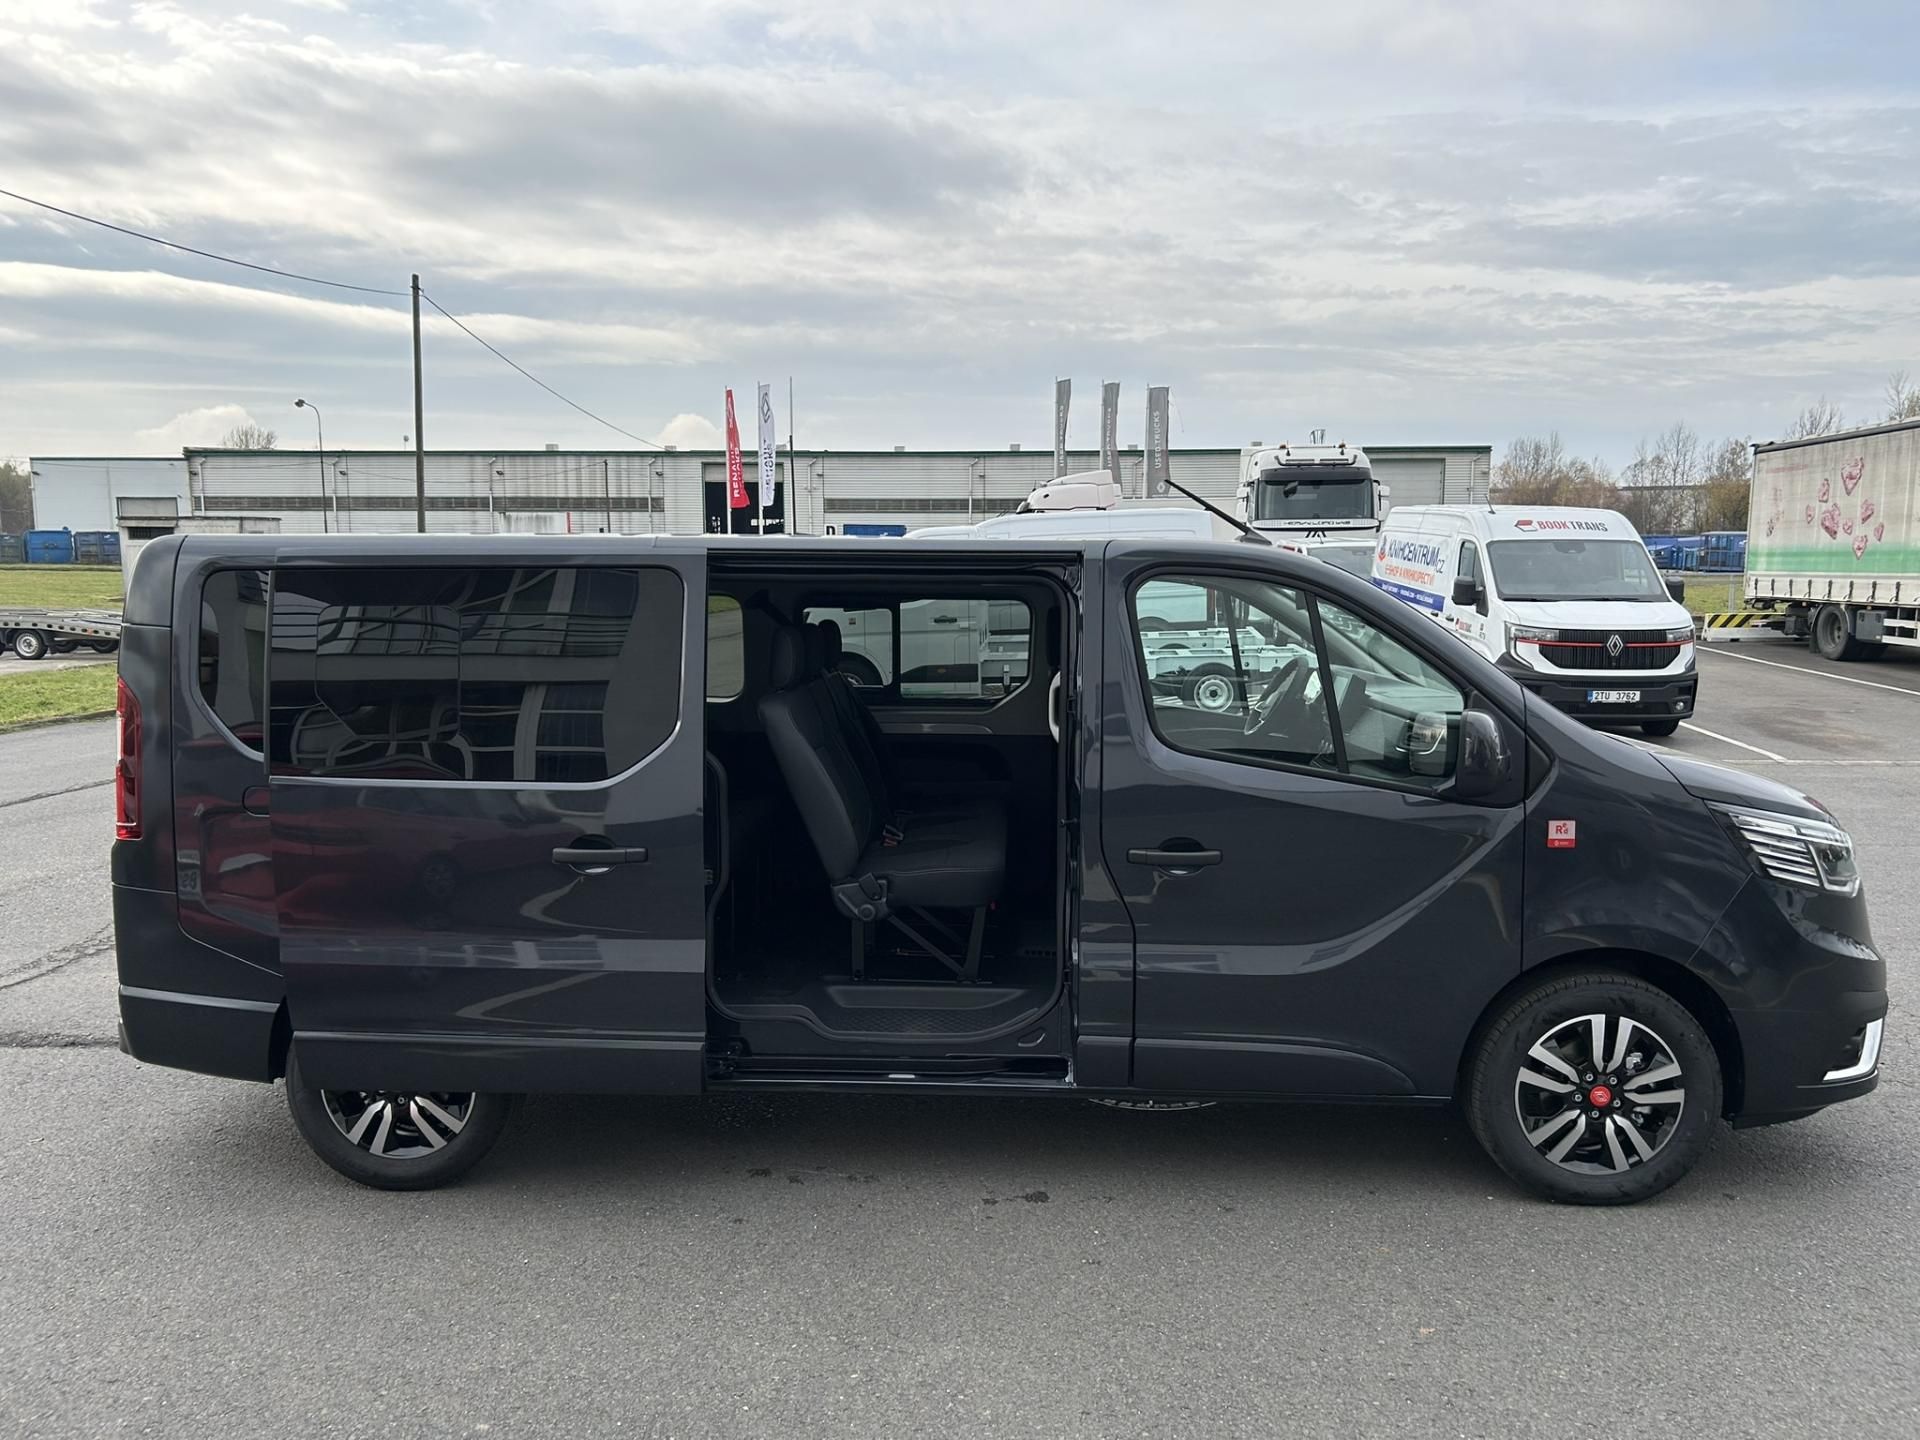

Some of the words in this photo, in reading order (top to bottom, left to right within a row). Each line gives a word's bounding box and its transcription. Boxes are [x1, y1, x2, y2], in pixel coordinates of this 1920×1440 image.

[1152, 410, 1161, 446] TRUCKS
[1153, 446, 1162, 469] USED
[1594, 691, 1611, 700] 2TU
[1616, 691, 1636, 701] 3762
